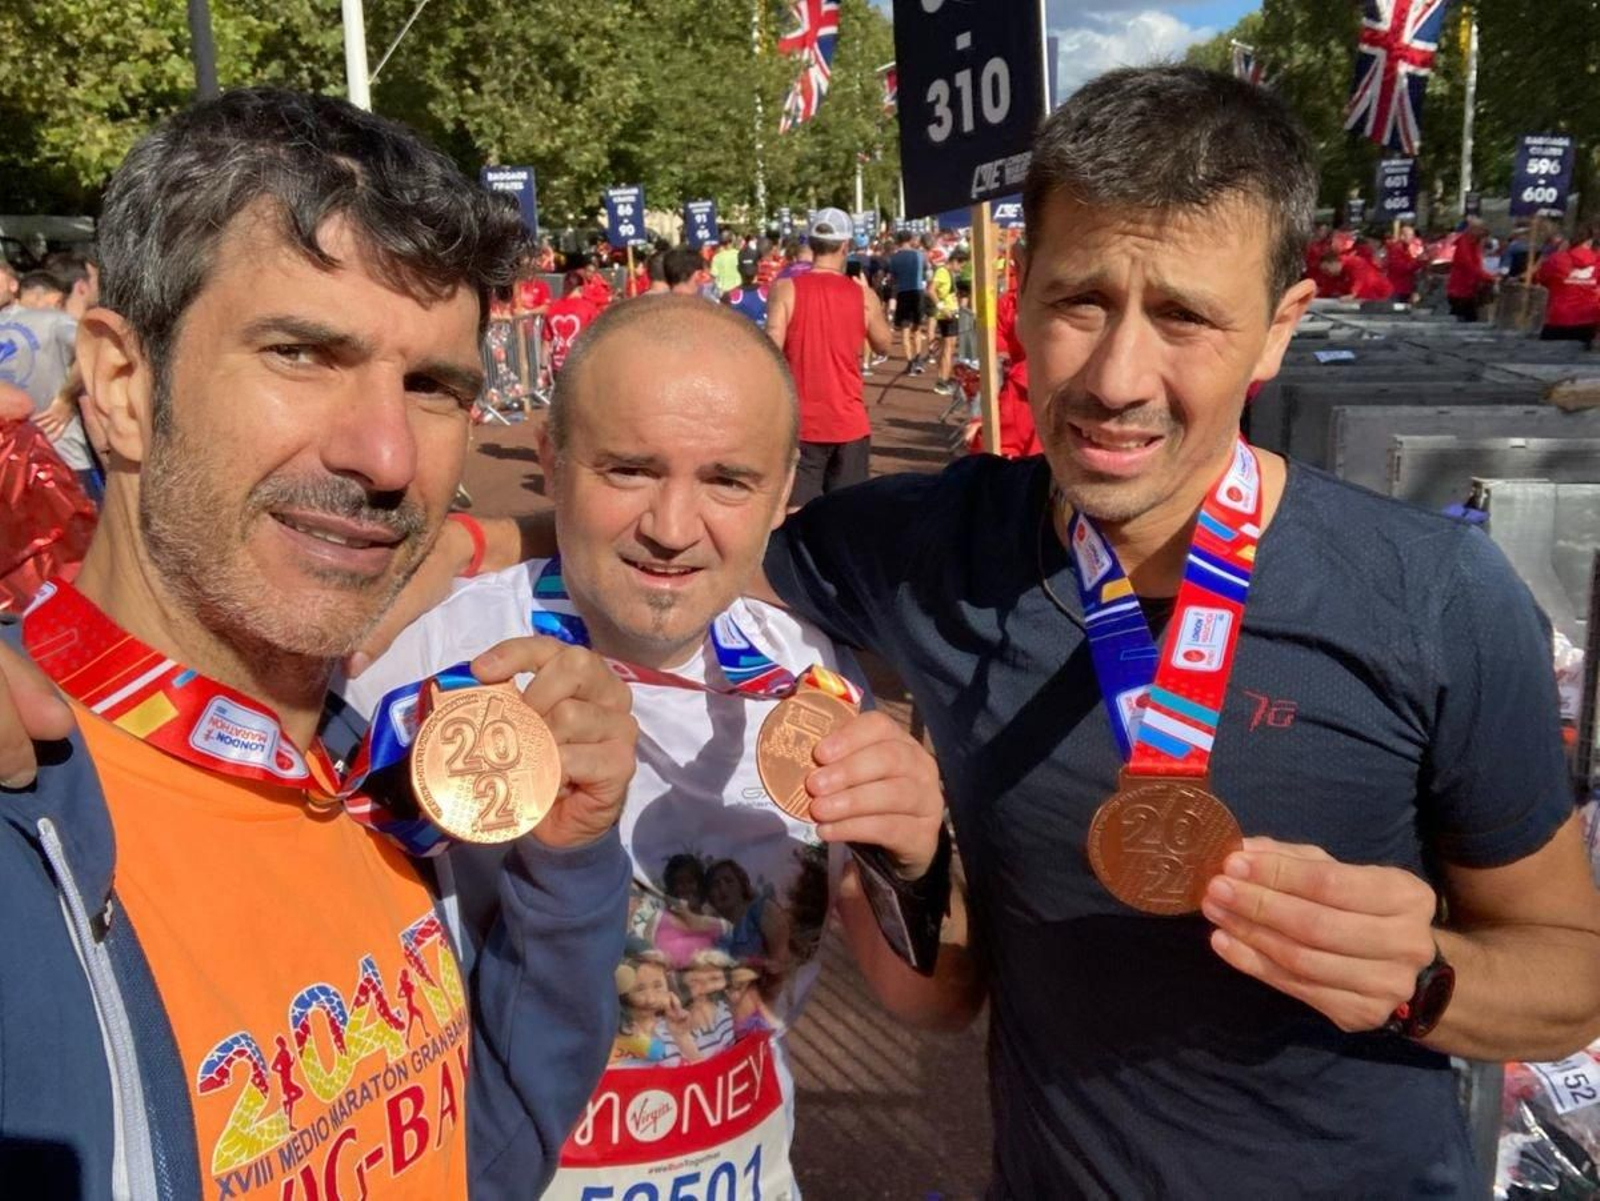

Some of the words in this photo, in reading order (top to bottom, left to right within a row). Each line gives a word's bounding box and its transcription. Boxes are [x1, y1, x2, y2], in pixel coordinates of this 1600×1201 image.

[926, 56, 1011, 142] 310
[1526, 158, 1561, 174] 596
[1522, 187, 1558, 203] 600
[619, 223, 636, 237] 90
[216, 731, 265, 753] LONDON
[214, 1161, 275, 1201] XVIII
[278, 1116, 330, 1174] MEDIO
[329, 1060, 409, 1132] MARATÓN
